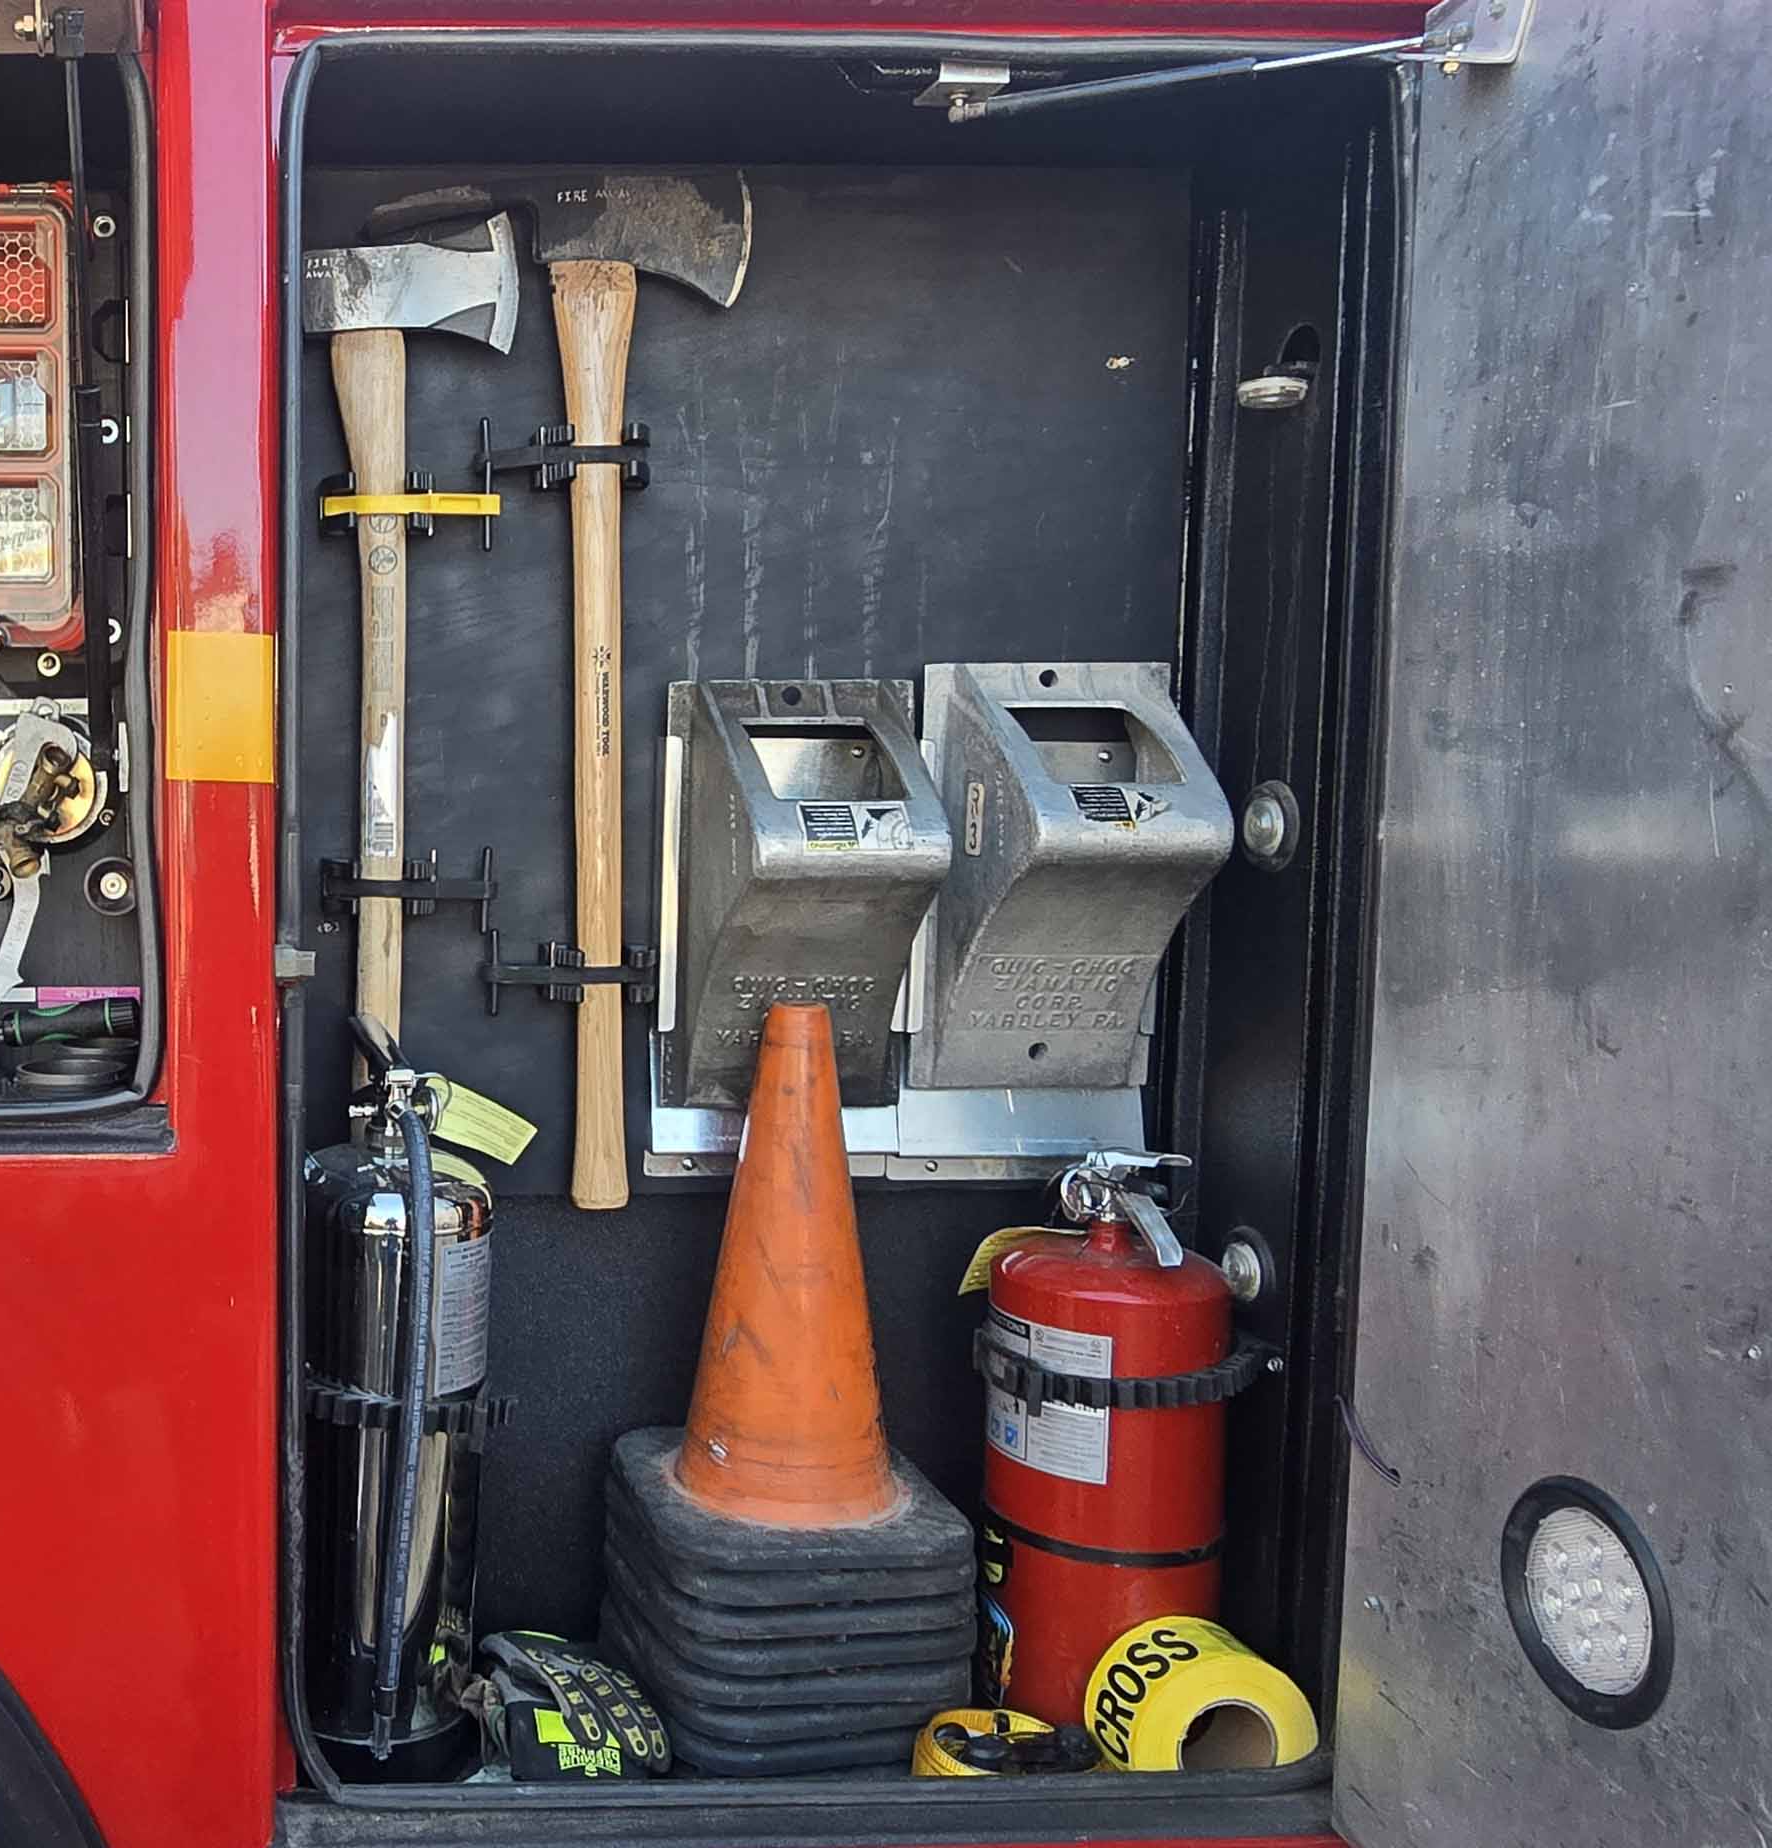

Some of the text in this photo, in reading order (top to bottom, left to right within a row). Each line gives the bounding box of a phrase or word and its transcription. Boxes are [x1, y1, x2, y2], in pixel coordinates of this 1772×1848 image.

[556, 189, 588, 203] FIRE
[602, 729, 610, 757] TOOL
[1094, 1629, 1199, 1764] CROSS
